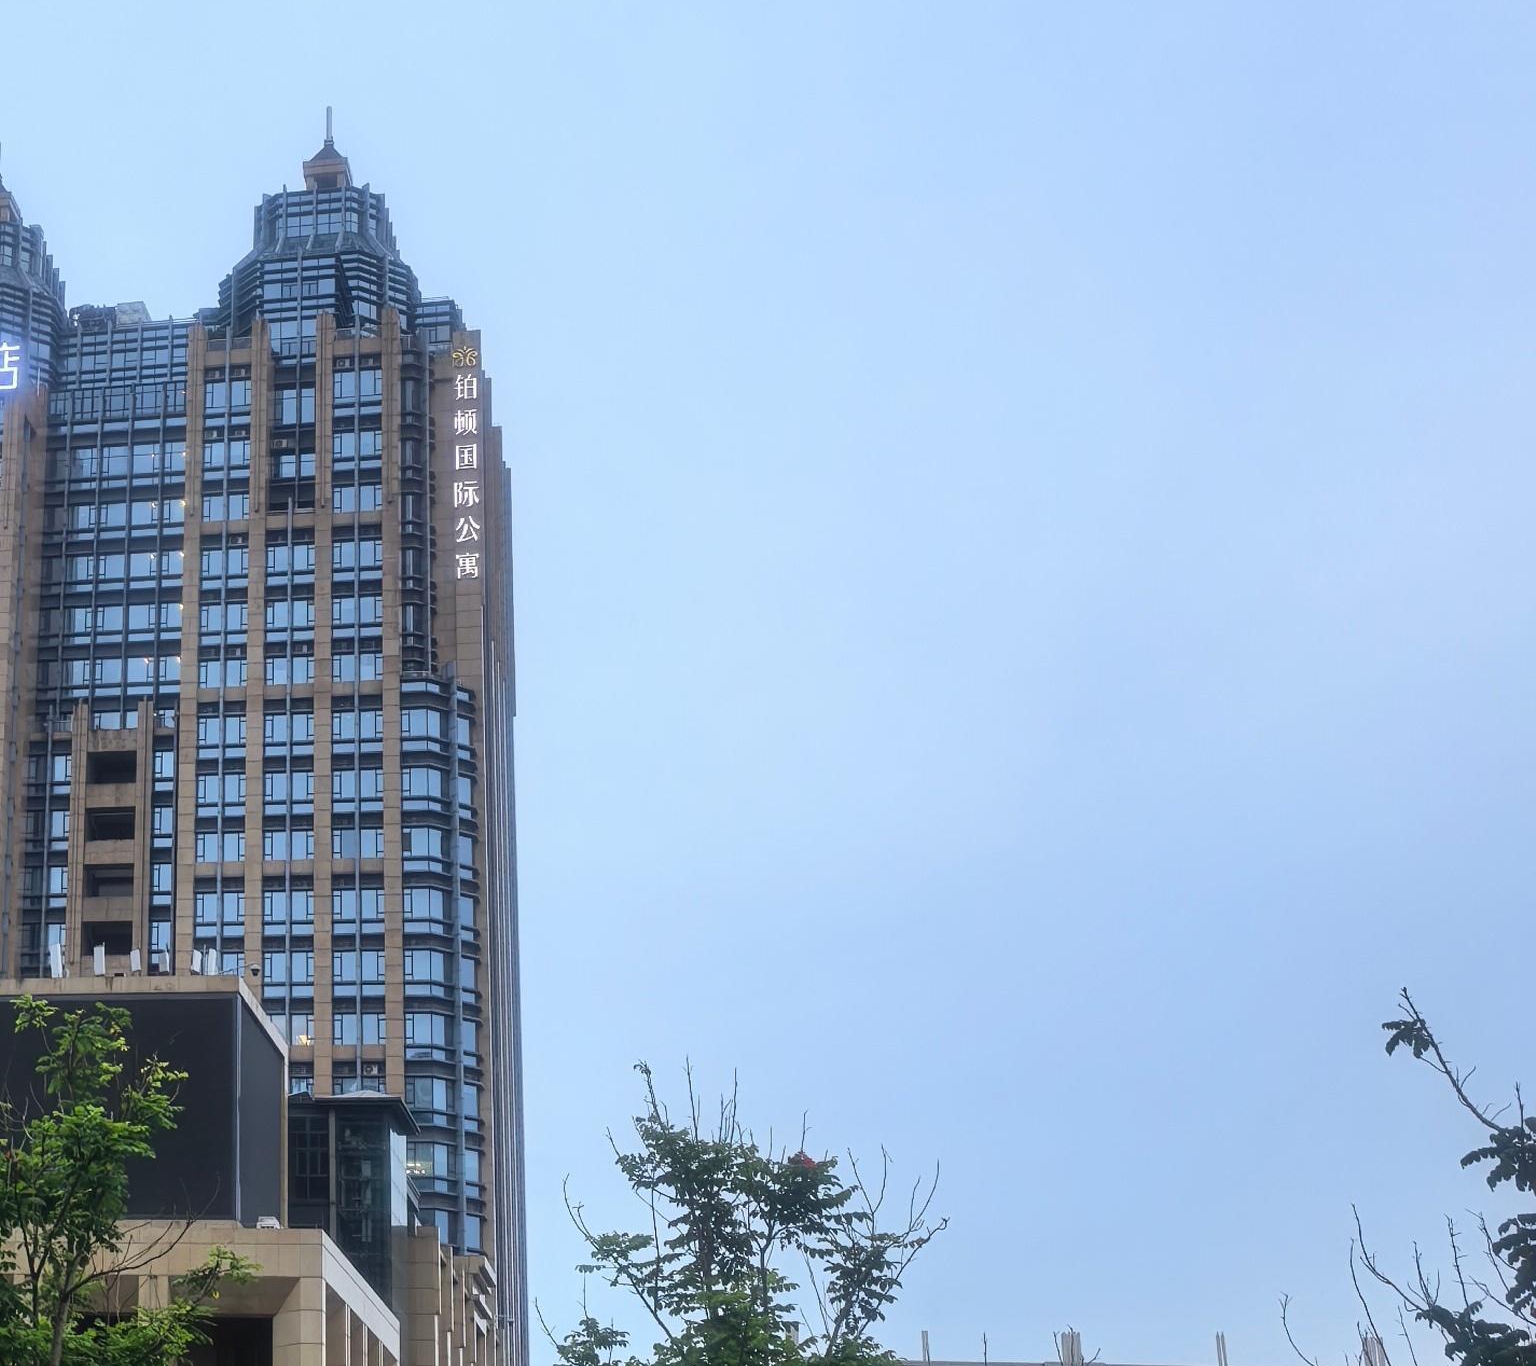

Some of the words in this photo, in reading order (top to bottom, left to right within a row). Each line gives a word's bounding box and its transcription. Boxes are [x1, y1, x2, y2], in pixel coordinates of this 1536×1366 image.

[454, 374, 480, 579] 铂顿国际公寓
